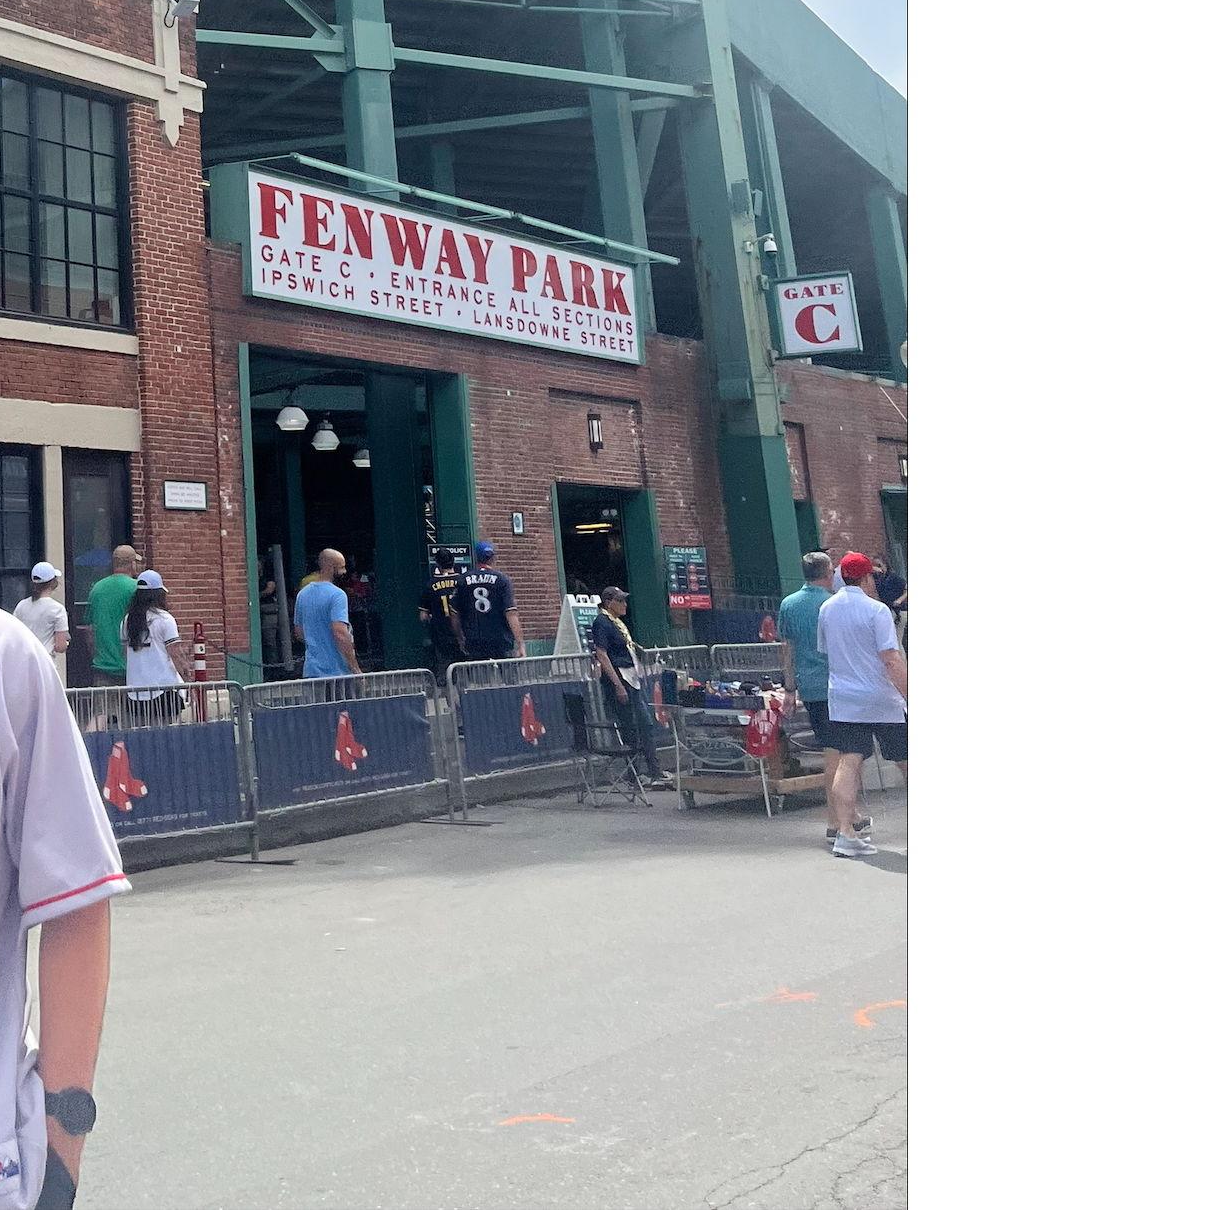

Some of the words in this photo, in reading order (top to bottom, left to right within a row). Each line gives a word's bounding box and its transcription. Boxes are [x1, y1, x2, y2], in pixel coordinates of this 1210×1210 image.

[257, 182, 494, 285] FENWAY
[509, 245, 632, 316] PARK
[261, 244, 322, 273] GATE
[340, 261, 351, 279] C
[390, 271, 497, 308] ENTRANCE
[509, 297, 541, 317] ALL
[552, 306, 633, 336] SECTIONS
[783, 283, 844, 300] GATE
[262, 268, 355, 301] IPSWICH
[370, 290, 445, 318] STREET
[473, 309, 571, 342] LANSDOWNE
[581, 331, 635, 353] STREET
[795, 303, 840, 344] C
[673, 547, 698, 555] PLEASE
[431, 580, 458, 591] CHOUR
[465, 573, 498, 586] BRAUN
[440, 595, 452, 617] 1
[473, 587, 491, 613] 8
[670, 595, 685, 605] NO
